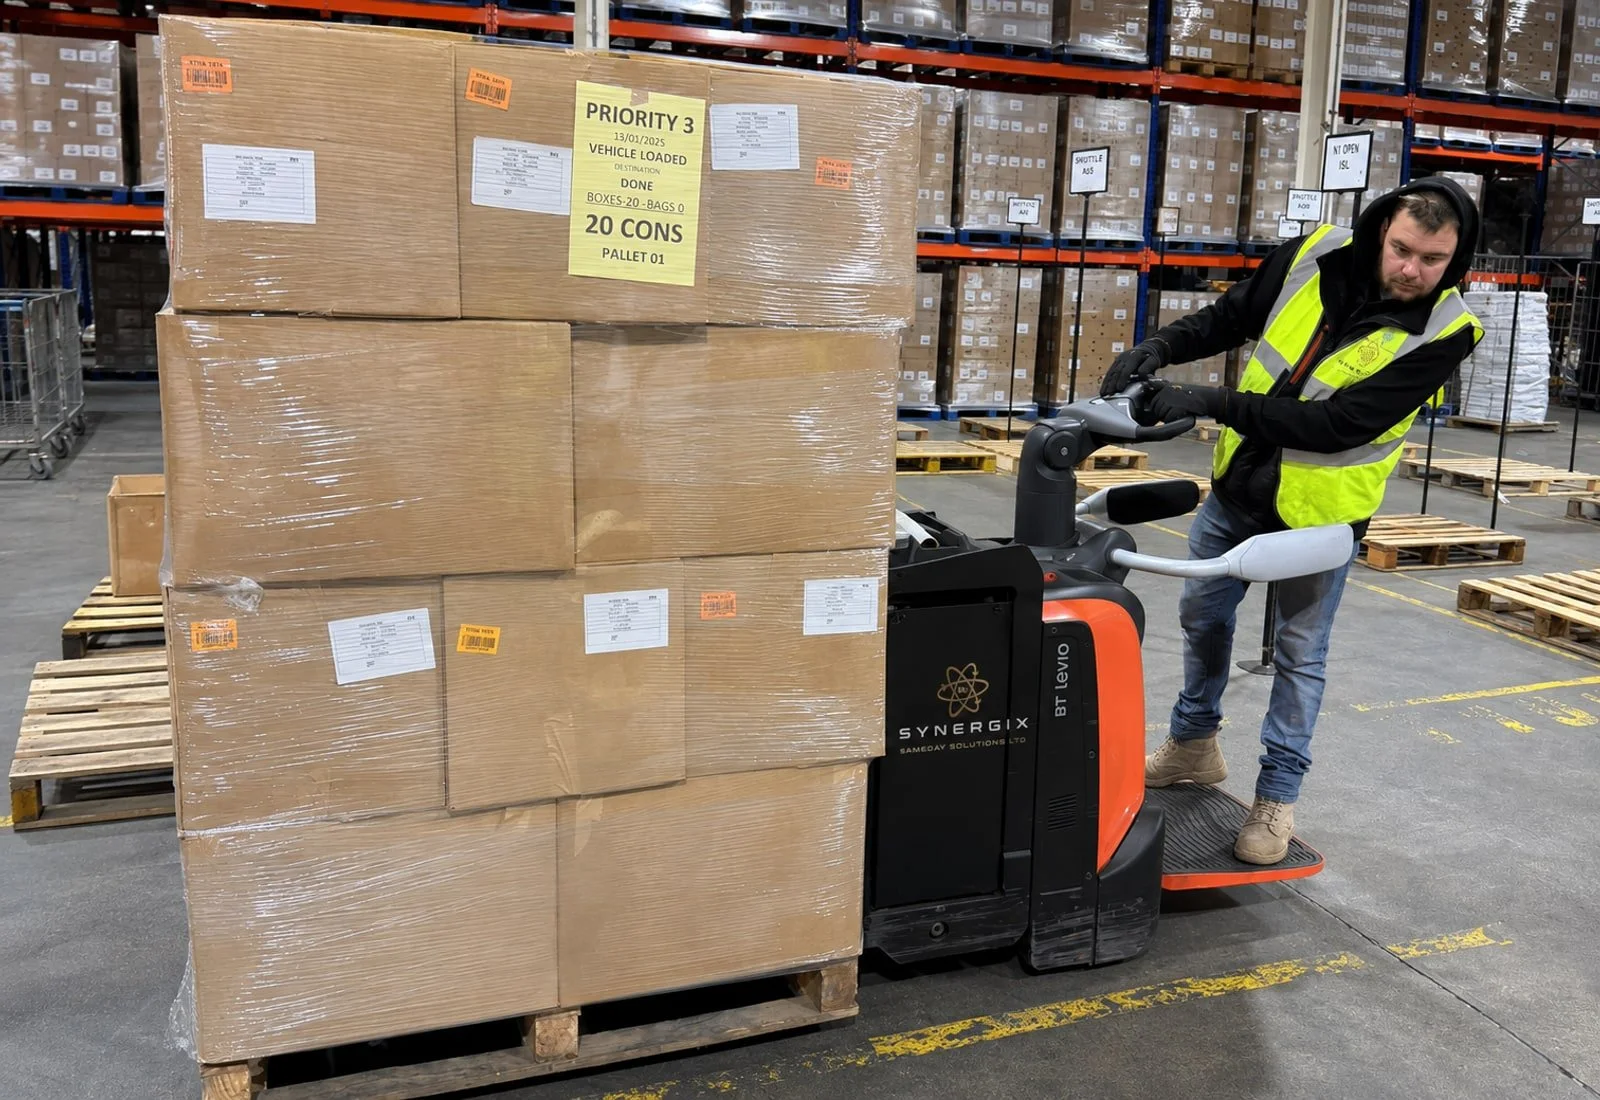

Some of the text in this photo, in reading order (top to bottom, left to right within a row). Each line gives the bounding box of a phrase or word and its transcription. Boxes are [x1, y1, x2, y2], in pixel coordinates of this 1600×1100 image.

[586, 102, 695, 134] PRIORITY 3
[614, 132, 665, 147] 13/01/2025
[589, 142, 688, 166] VEHICLE LOADED
[1343, 143, 1360, 155] OPEN
[614, 163, 661, 175] DESTINATION
[621, 178, 653, 191] DONE
[678, 203, 685, 213] 0
[585, 214, 683, 243] 20 CONS
[602, 247, 665, 265] PALLET 01
[1055, 696, 1067, 717] BT
[899, 717, 1029, 740] SYNERGIX
[900, 736, 1027, 754] SAMEDAY SOLUTIONS LTD
